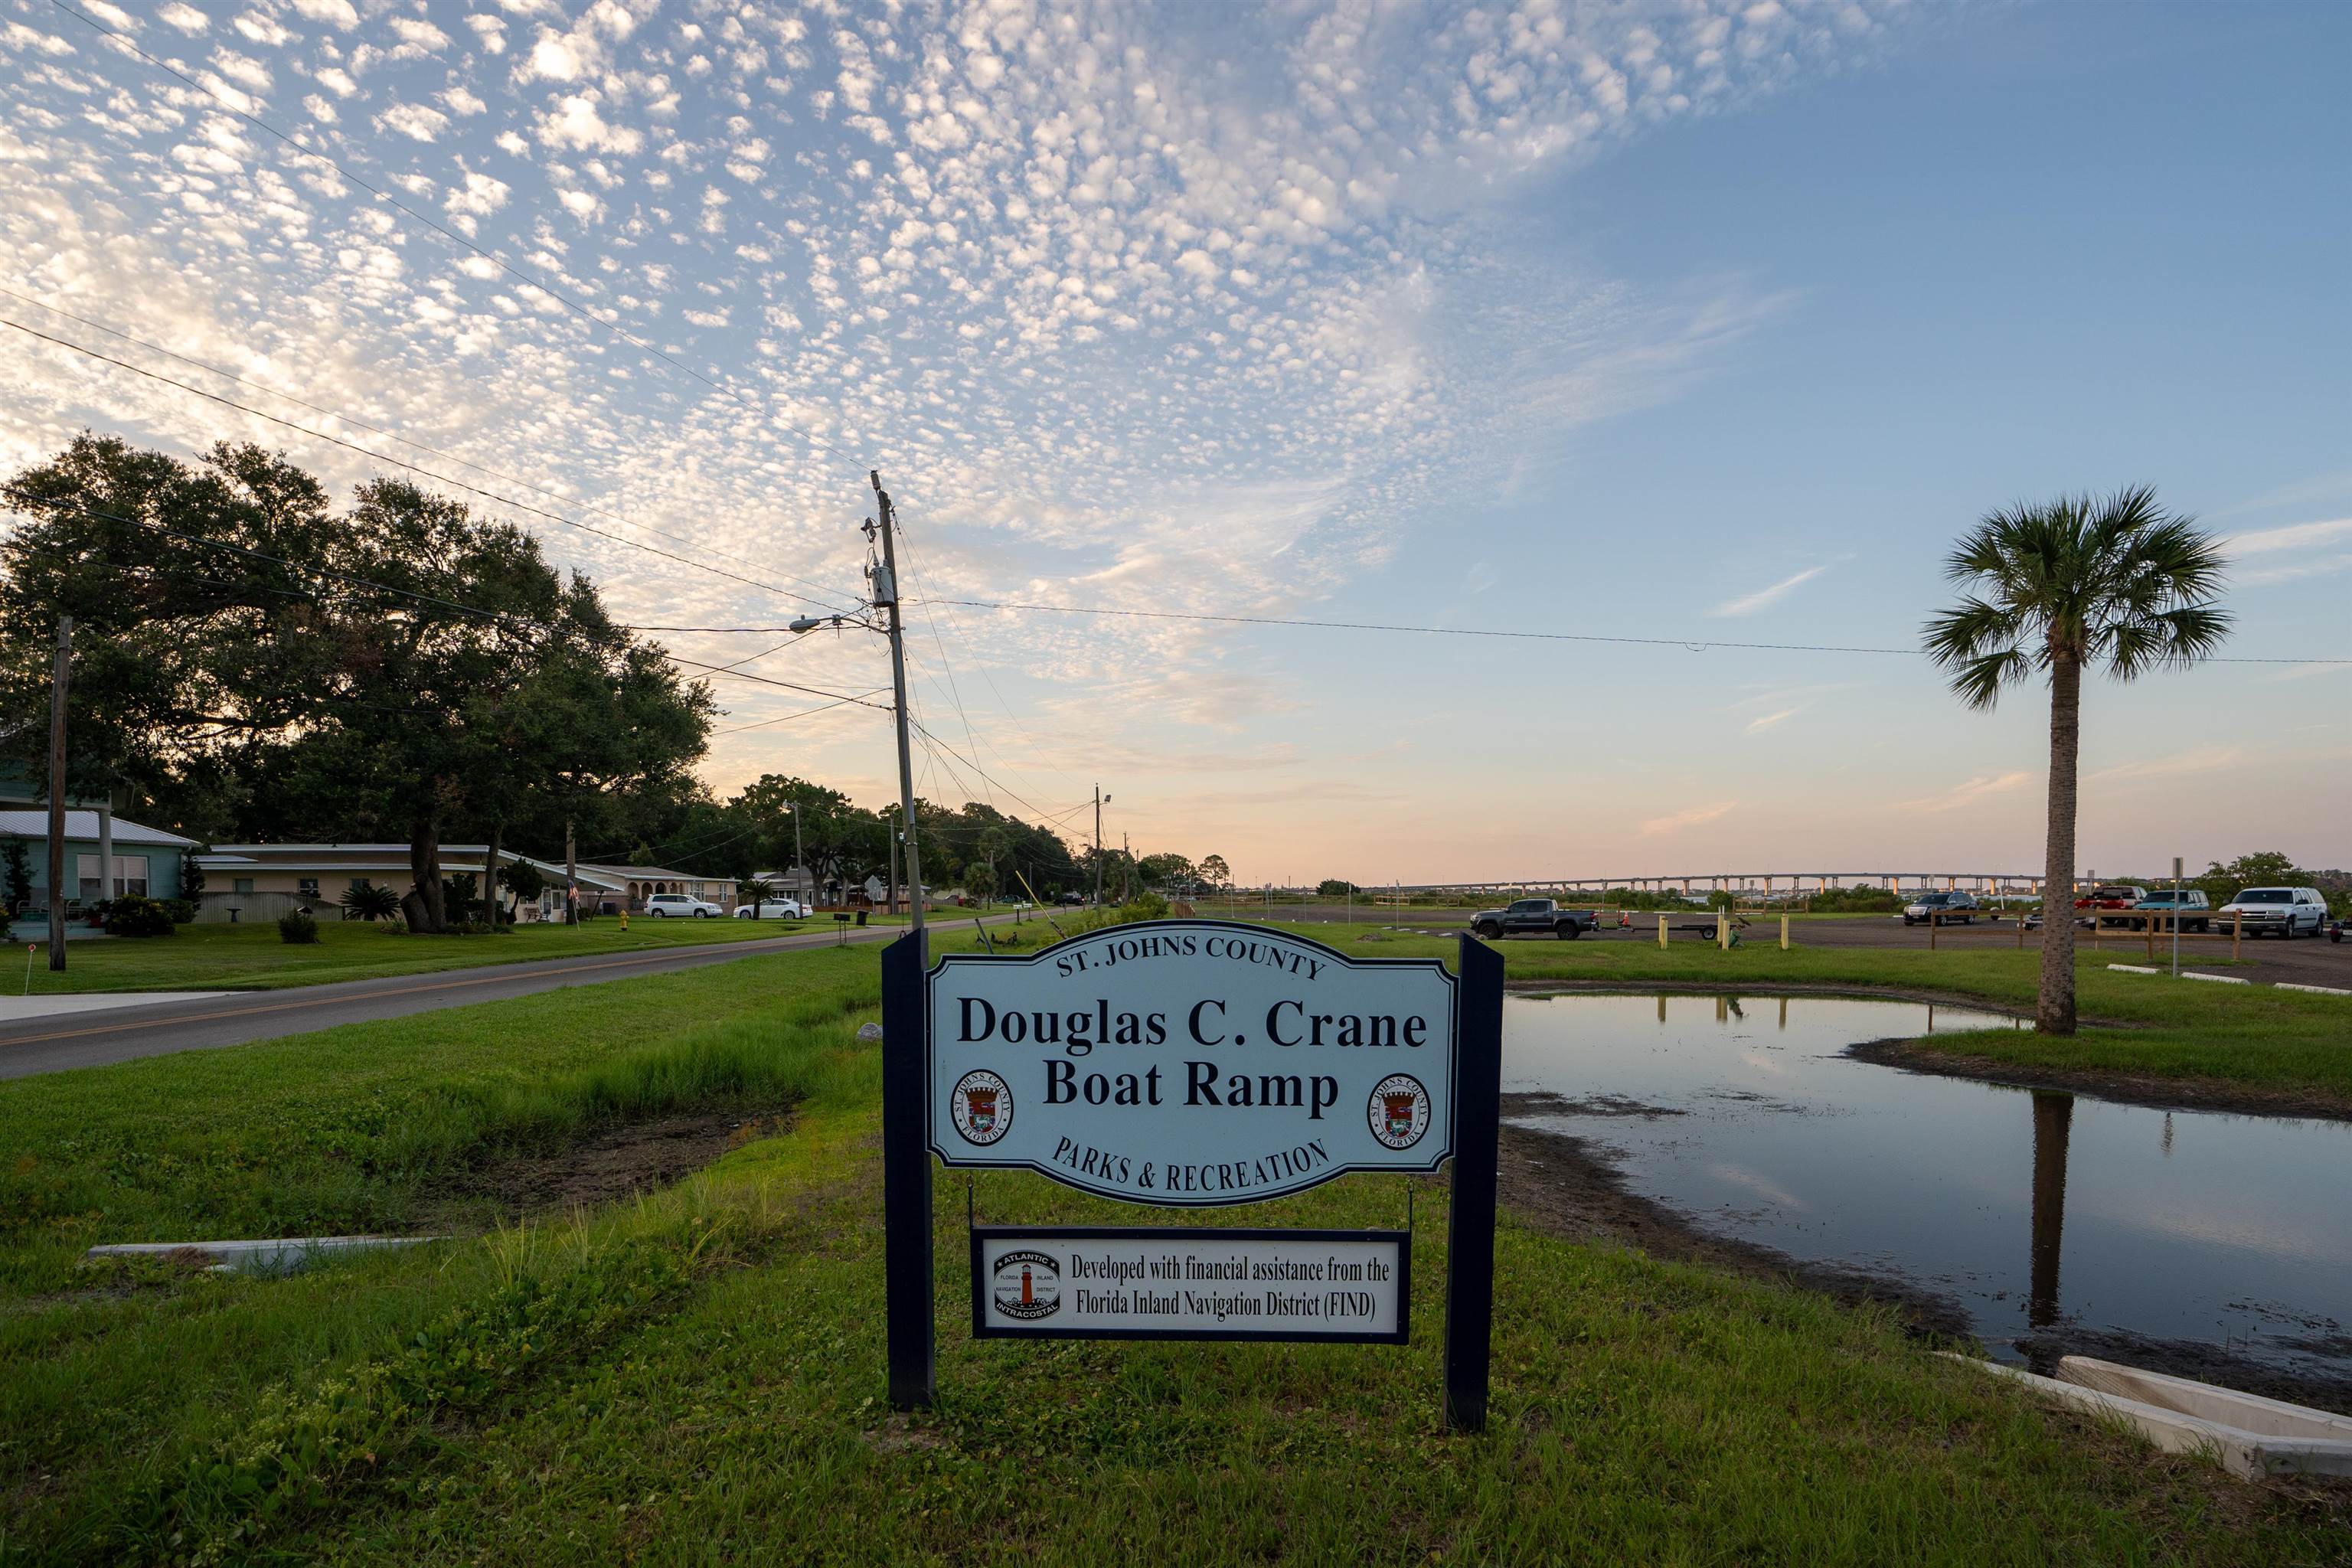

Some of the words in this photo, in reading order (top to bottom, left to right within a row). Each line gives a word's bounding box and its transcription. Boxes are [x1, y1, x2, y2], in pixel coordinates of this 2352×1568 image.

[1056, 949, 1100, 978] ST.
[1105, 936, 1197, 967] JOHNS
[1205, 936, 1328, 981] COUNTY
[956, 997, 1167, 1057] Douglas
[1188, 999, 1246, 1046] C.
[1266, 1000, 1427, 1047] Crane
[957, 1073, 985, 1096] JOHNS
[988, 1076, 1011, 1112] COUNTY
[1042, 1060, 1164, 1106] Boat
[1183, 1060, 1339, 1119] Ramp
[1374, 1077, 1403, 1100] JOHNS
[1406, 1080, 1427, 1117] COUNTY
[962, 1126, 1004, 1142] FLORIDA
[1377, 1131, 1420, 1147] FLORIDA
[1051, 1135, 1132, 1184] PARKS
[1138, 1161, 1156, 1189] &
[1165, 1138, 1330, 1191] RECREATION
[1004, 1253, 1049, 1264] ATLANTIC
[1071, 1254, 1145, 1285] Developed
[1150, 1255, 1181, 1279] with
[1186, 1255, 1248, 1280] financial
[1253, 1256, 1323, 1281] assistance
[1328, 1256, 1362, 1281] from
[1367, 1257, 1390, 1281] the
[996, 1302, 1058, 1318] INTRACOSTAL
[1076, 1289, 1128, 1314] Florida
[1132, 1290, 1179, 1314] Inland
[1184, 1291, 1261, 1322] Navigation
[1266, 1291, 1320, 1316] District
[1324, 1292, 1376, 1322] (FIND)
